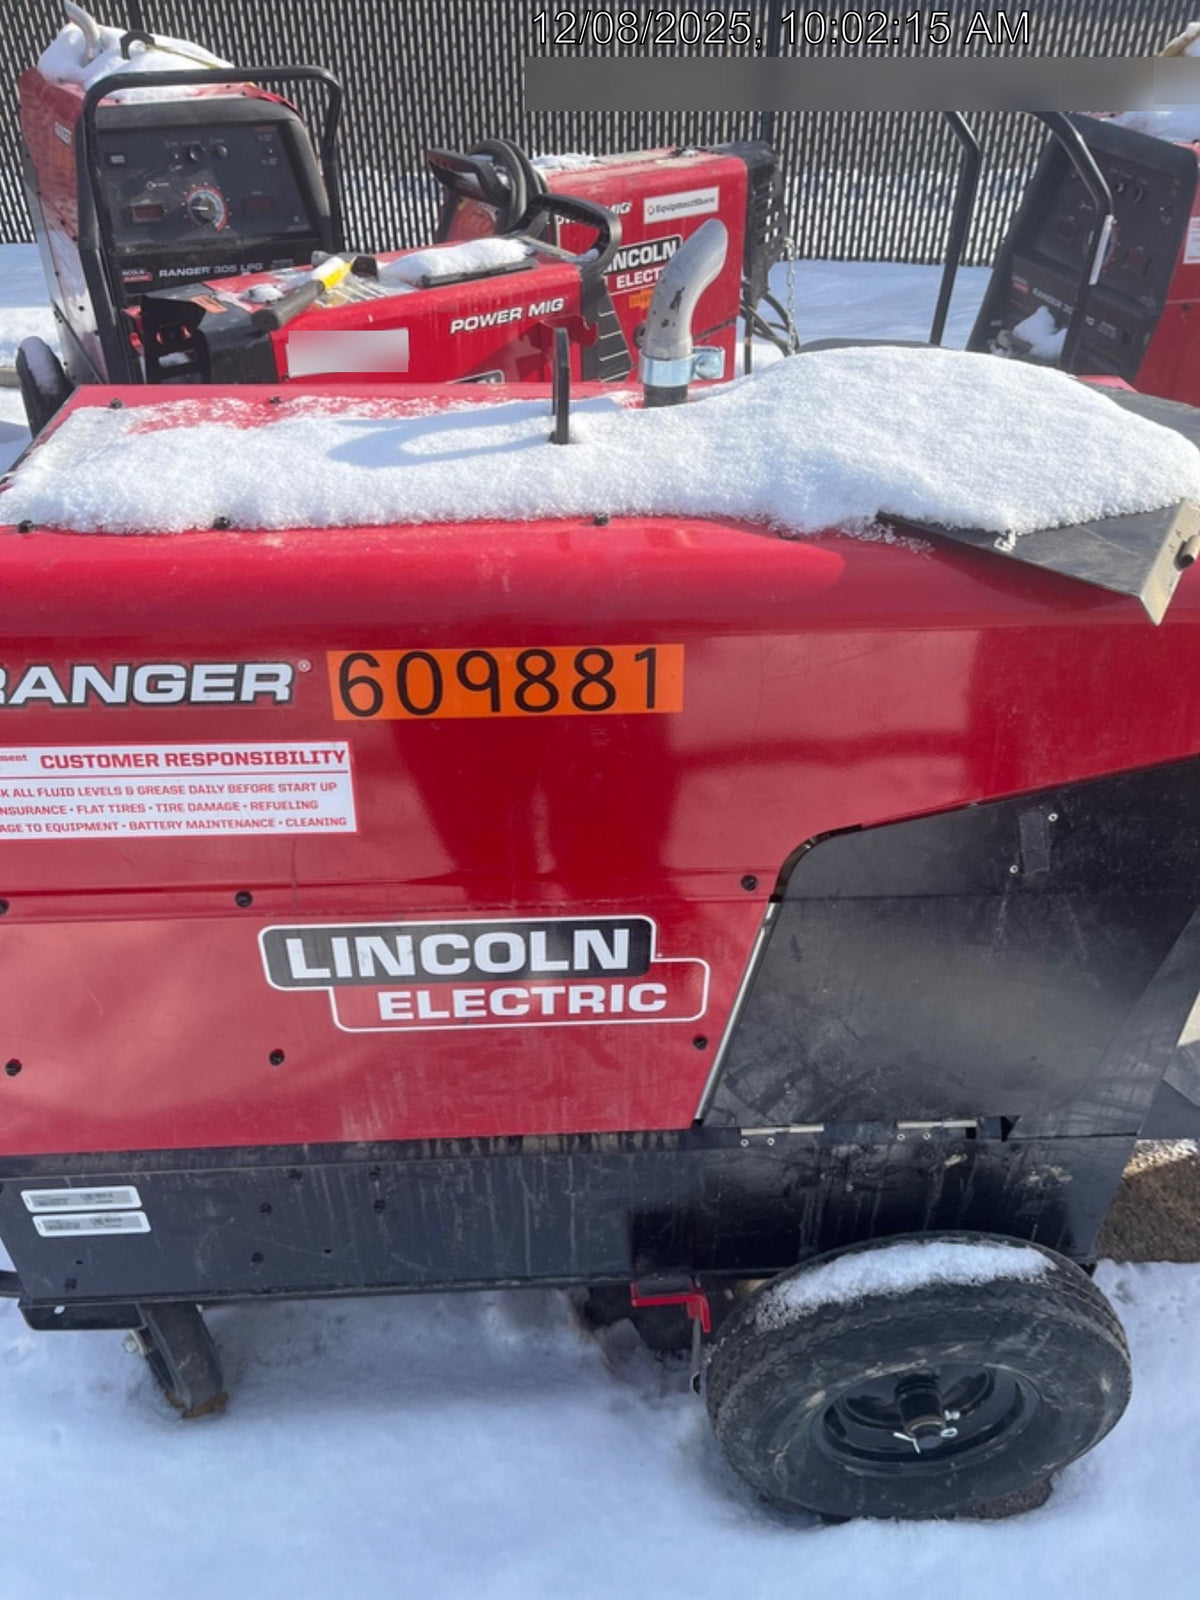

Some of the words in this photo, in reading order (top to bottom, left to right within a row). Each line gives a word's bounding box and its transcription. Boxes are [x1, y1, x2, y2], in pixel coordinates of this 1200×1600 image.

[604, 240, 677, 272] NCOLN
[158, 266, 210, 278] RANGER
[616, 267, 662, 289] ELECT
[450, 306, 524, 335] POWER
[528, 298, 565, 317] MIG
[0, 661, 296, 707] ANGER
[338, 647, 658, 718] 609881
[40, 753, 160, 769] CUSTOMER
[164, 749, 345, 768] RESPONSIBILITY
[13, 788, 34, 798] ALL
[37, 787, 75, 798] FLUID
[77, 786, 122, 797] LEVELS
[137, 785, 186, 796] GREASE
[188, 784, 225, 795] DAILY
[227, 783, 275, 794] BEFORE
[278, 782, 317, 793] START
[320, 782, 337, 792] UP
[76, 804, 105, 815] FLAT
[108, 803, 146, 814] TIRES
[155, 803, 185, 813] TIRE
[187, 801, 241, 812] DAMAGE
[250, 800, 318, 811] REFUELING
[26, 823, 42, 833] TO
[45, 821, 119, 833] EQUIPMENT
[128, 820, 182, 831] BATTERY
[186, 818, 276, 830] MAINTENANCE
[285, 817, 348, 828] CLEANING
[285, 928, 630, 979] LINCOLN
[377, 983, 668, 1020] ELECTRIC
